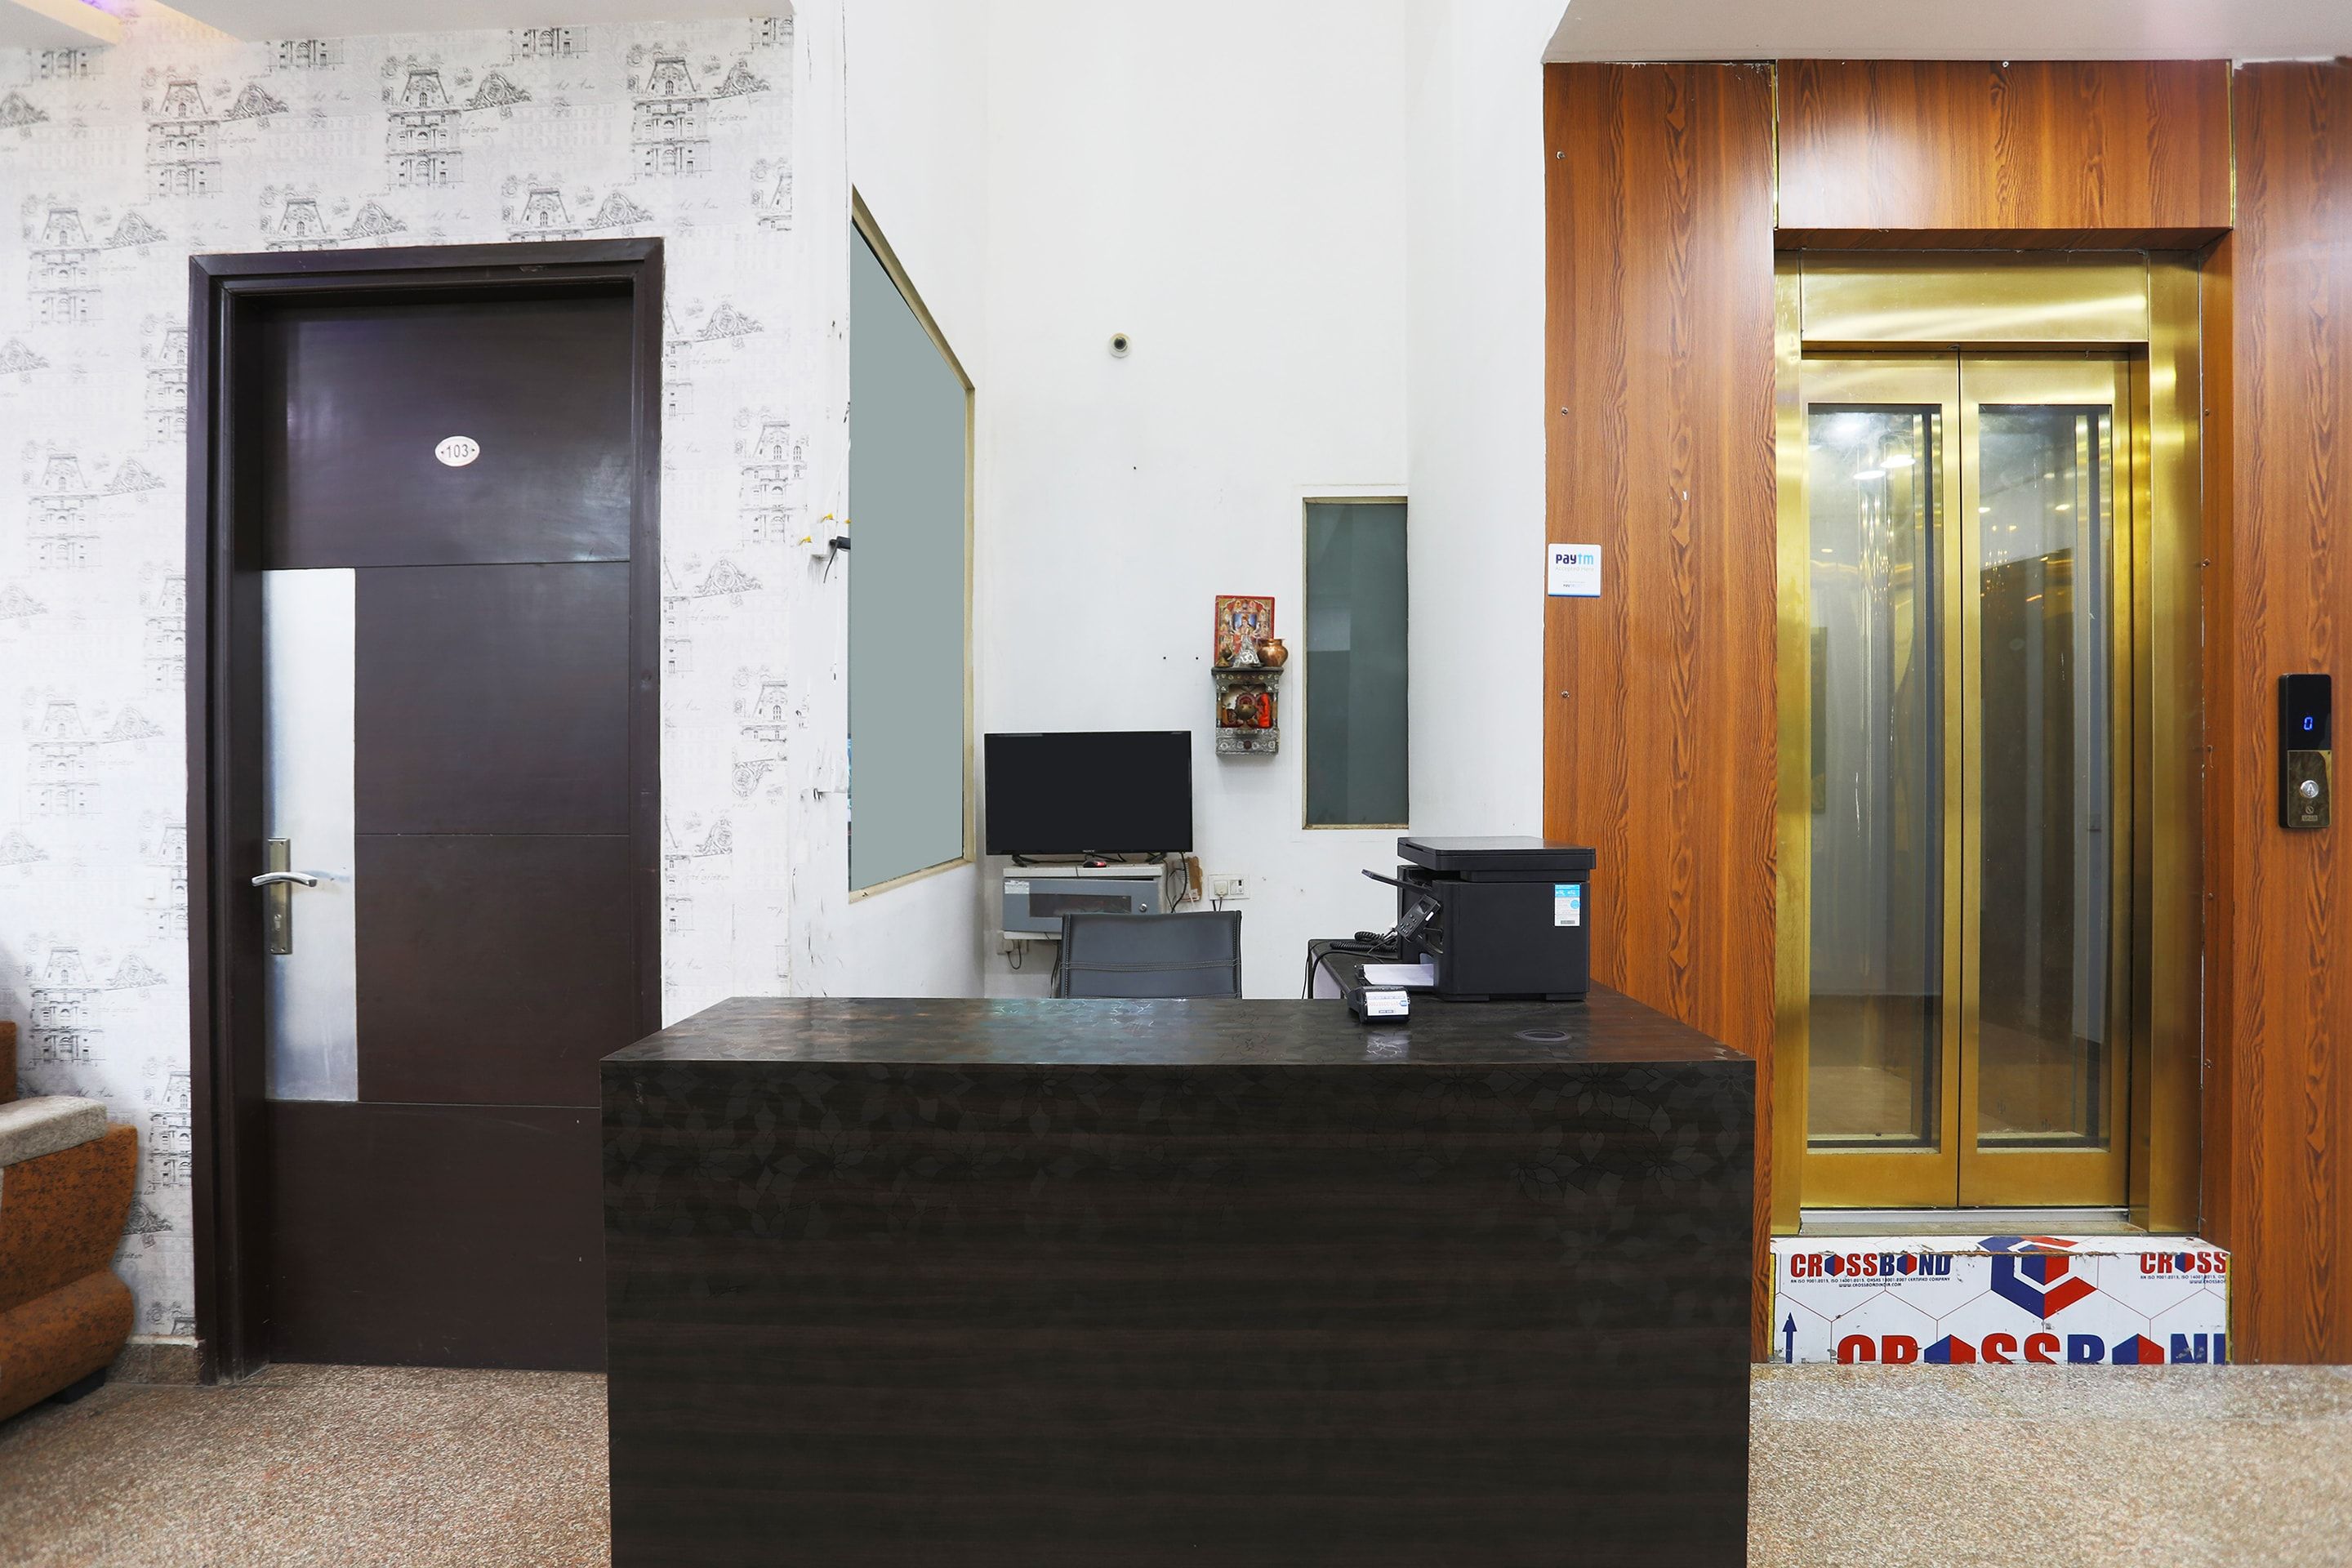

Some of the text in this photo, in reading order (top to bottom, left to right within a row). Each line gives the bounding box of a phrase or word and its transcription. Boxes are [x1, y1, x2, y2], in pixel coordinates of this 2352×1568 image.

[447, 443, 469, 458] 103
[1556, 553, 1594, 564] paytm
[2303, 717, 2313, 730] 0
[1789, 1252, 1952, 1277] CROSSBOND
